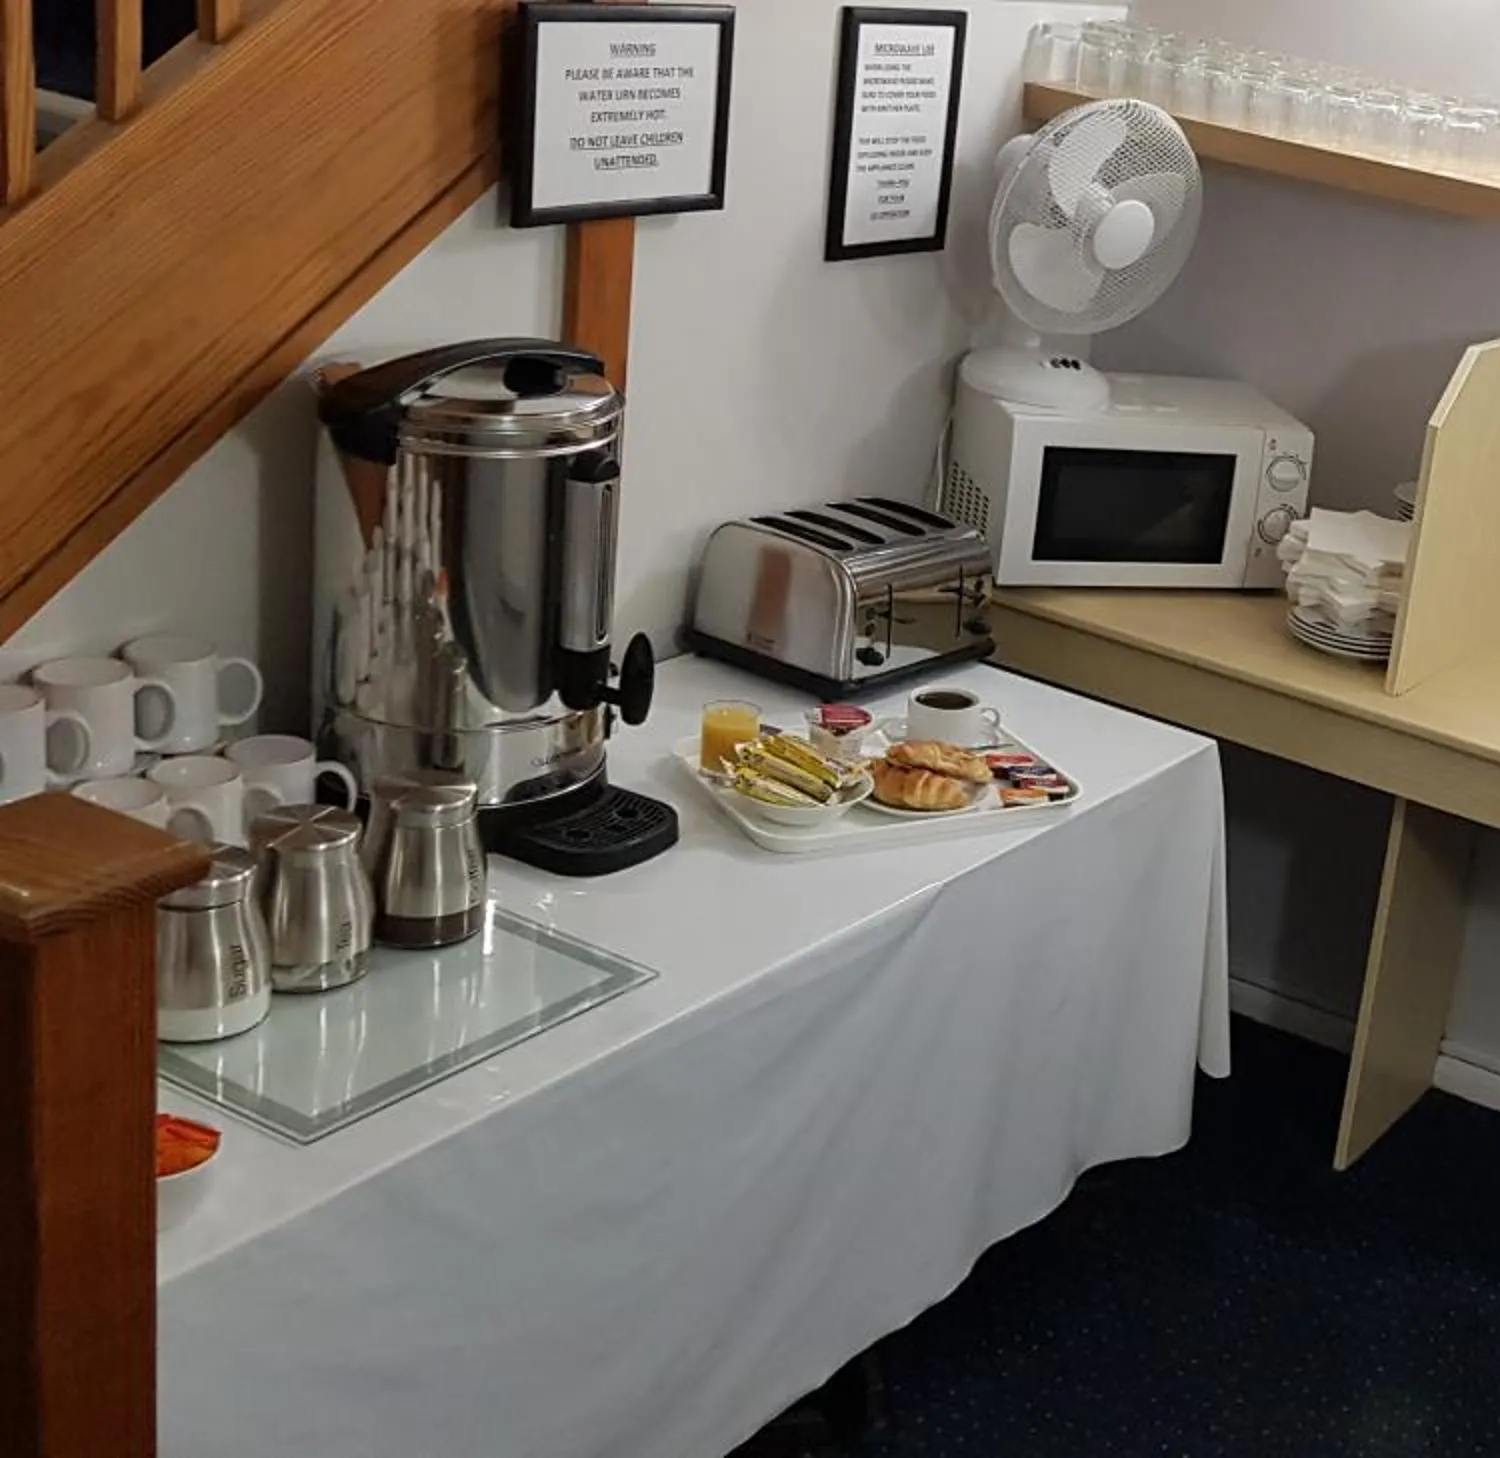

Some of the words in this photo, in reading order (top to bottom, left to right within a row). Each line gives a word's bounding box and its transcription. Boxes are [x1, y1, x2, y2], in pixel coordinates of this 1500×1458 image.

[609, 43, 657, 57] WARNING
[564, 68, 600, 80] PLEASE
[601, 68, 615, 79] BE
[615, 67, 650, 79] AWARE
[653, 66, 676, 78] THAT
[677, 66, 694, 78] THE
[578, 89, 613, 101] WATER
[615, 88, 635, 100] URN
[637, 87, 681, 99] BECOMES
[591, 111, 643, 123] EXTREMELY
[569, 137, 586, 150] DO
[587, 136, 608, 149] NOT
[609, 134, 638, 148] LEAVE
[640, 131, 684, 146] CHILDREN
